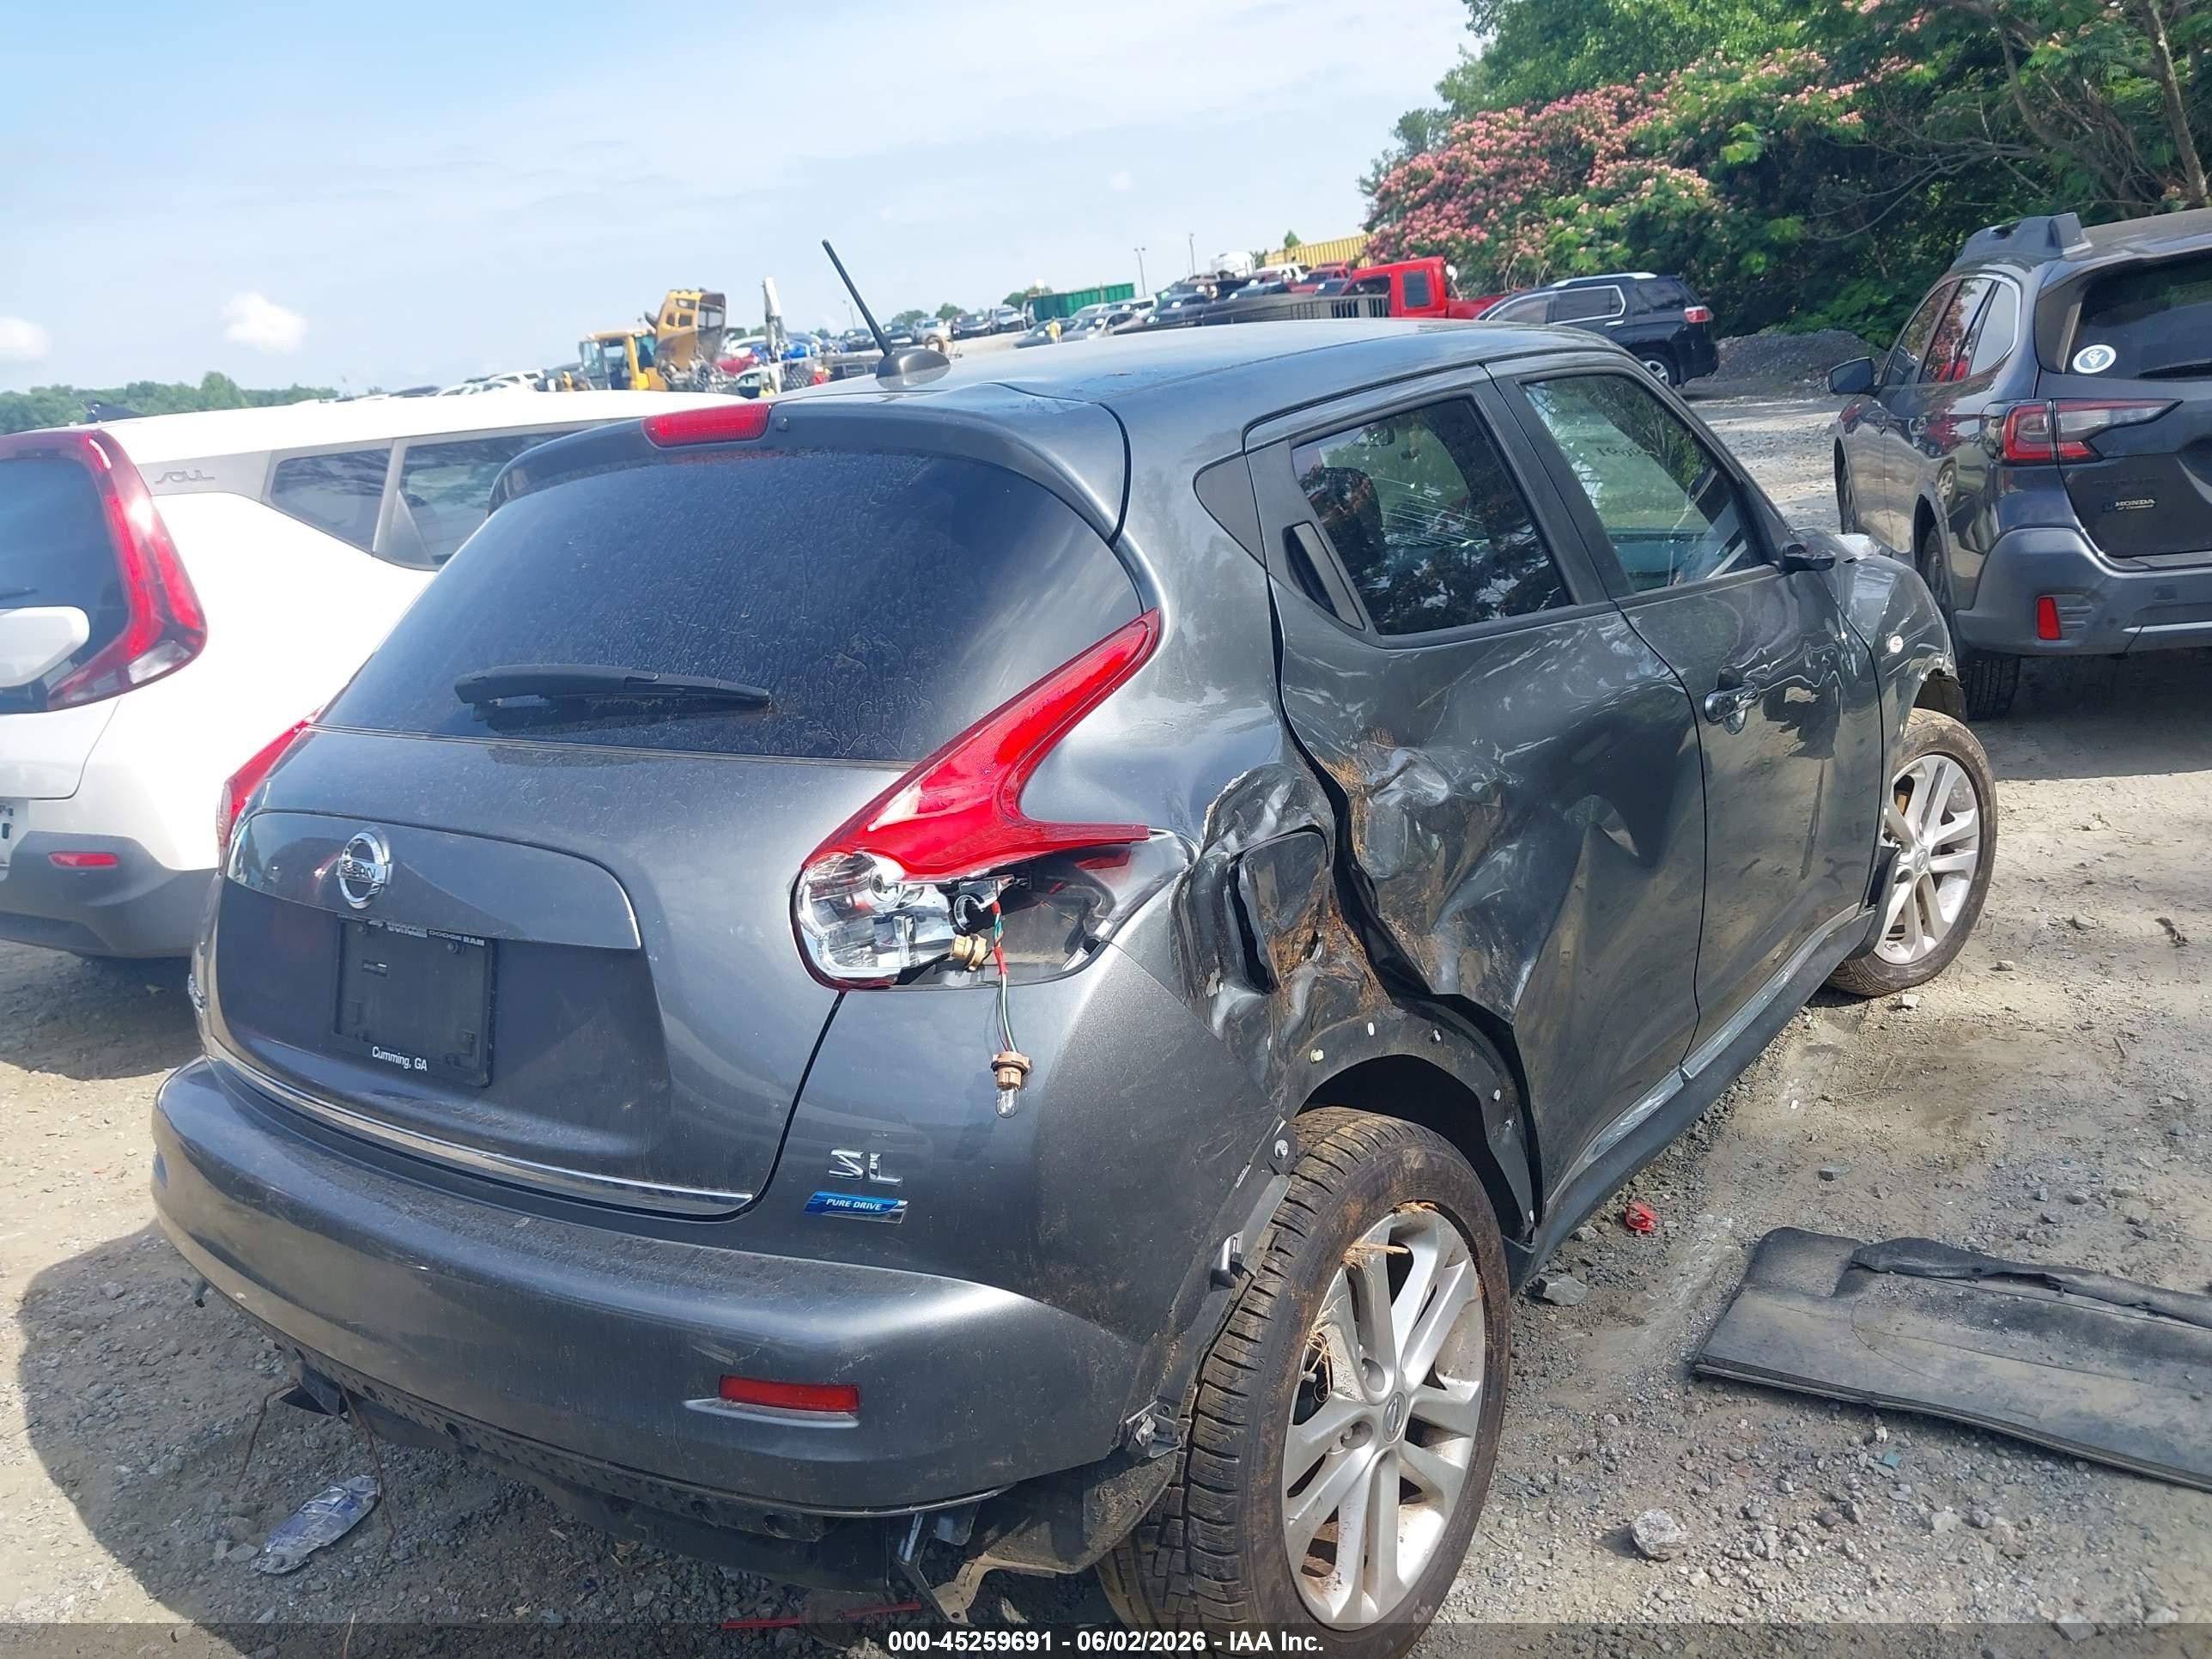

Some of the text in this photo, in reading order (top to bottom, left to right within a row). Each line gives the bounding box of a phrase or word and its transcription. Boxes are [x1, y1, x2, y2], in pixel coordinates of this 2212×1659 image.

[2114, 499, 2155, 507] HONDA
[463, 936, 485, 947] RAM
[372, 1046, 428, 1073] Cumming, GA
[827, 1148, 902, 1187] SL
[825, 1198, 884, 1212] PURE DRIVE
